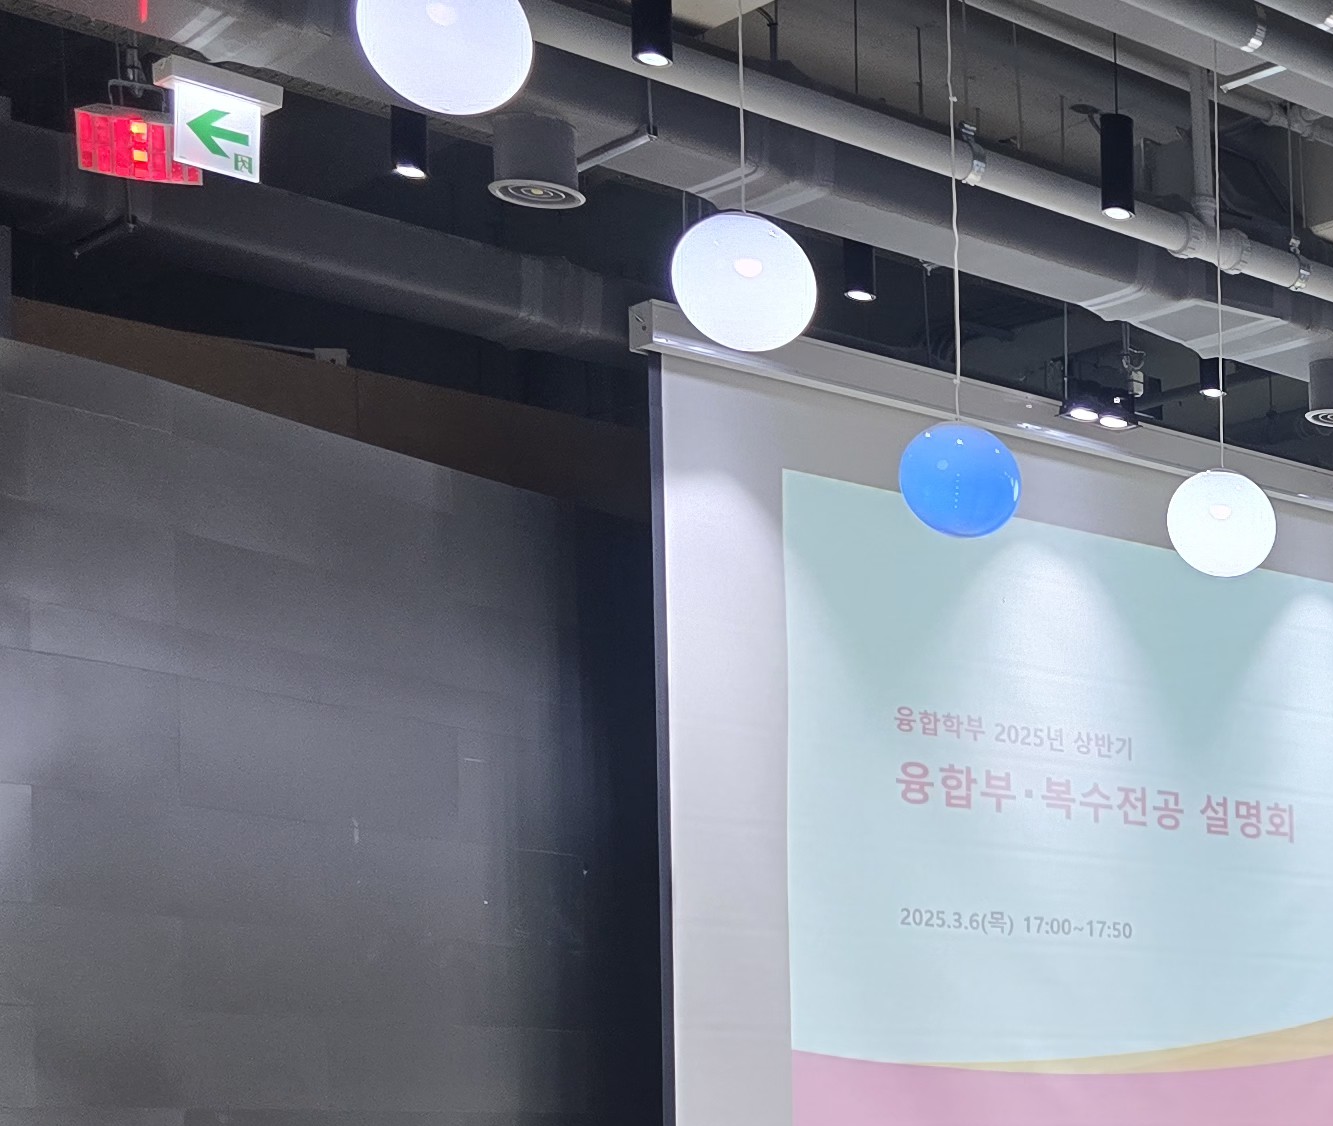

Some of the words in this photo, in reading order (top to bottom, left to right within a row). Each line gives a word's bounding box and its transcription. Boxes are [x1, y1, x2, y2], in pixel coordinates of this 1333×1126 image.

[894, 706, 985, 742] 융합학부
[994, 723, 1065, 753] 2025년
[1073, 731, 1133, 761] 상반기
[1200, 794, 1295, 844] 설명회
[900, 907, 1014, 936] 2025.3.6(목)
[1023, 916, 1133, 939] 17:00~17:50
